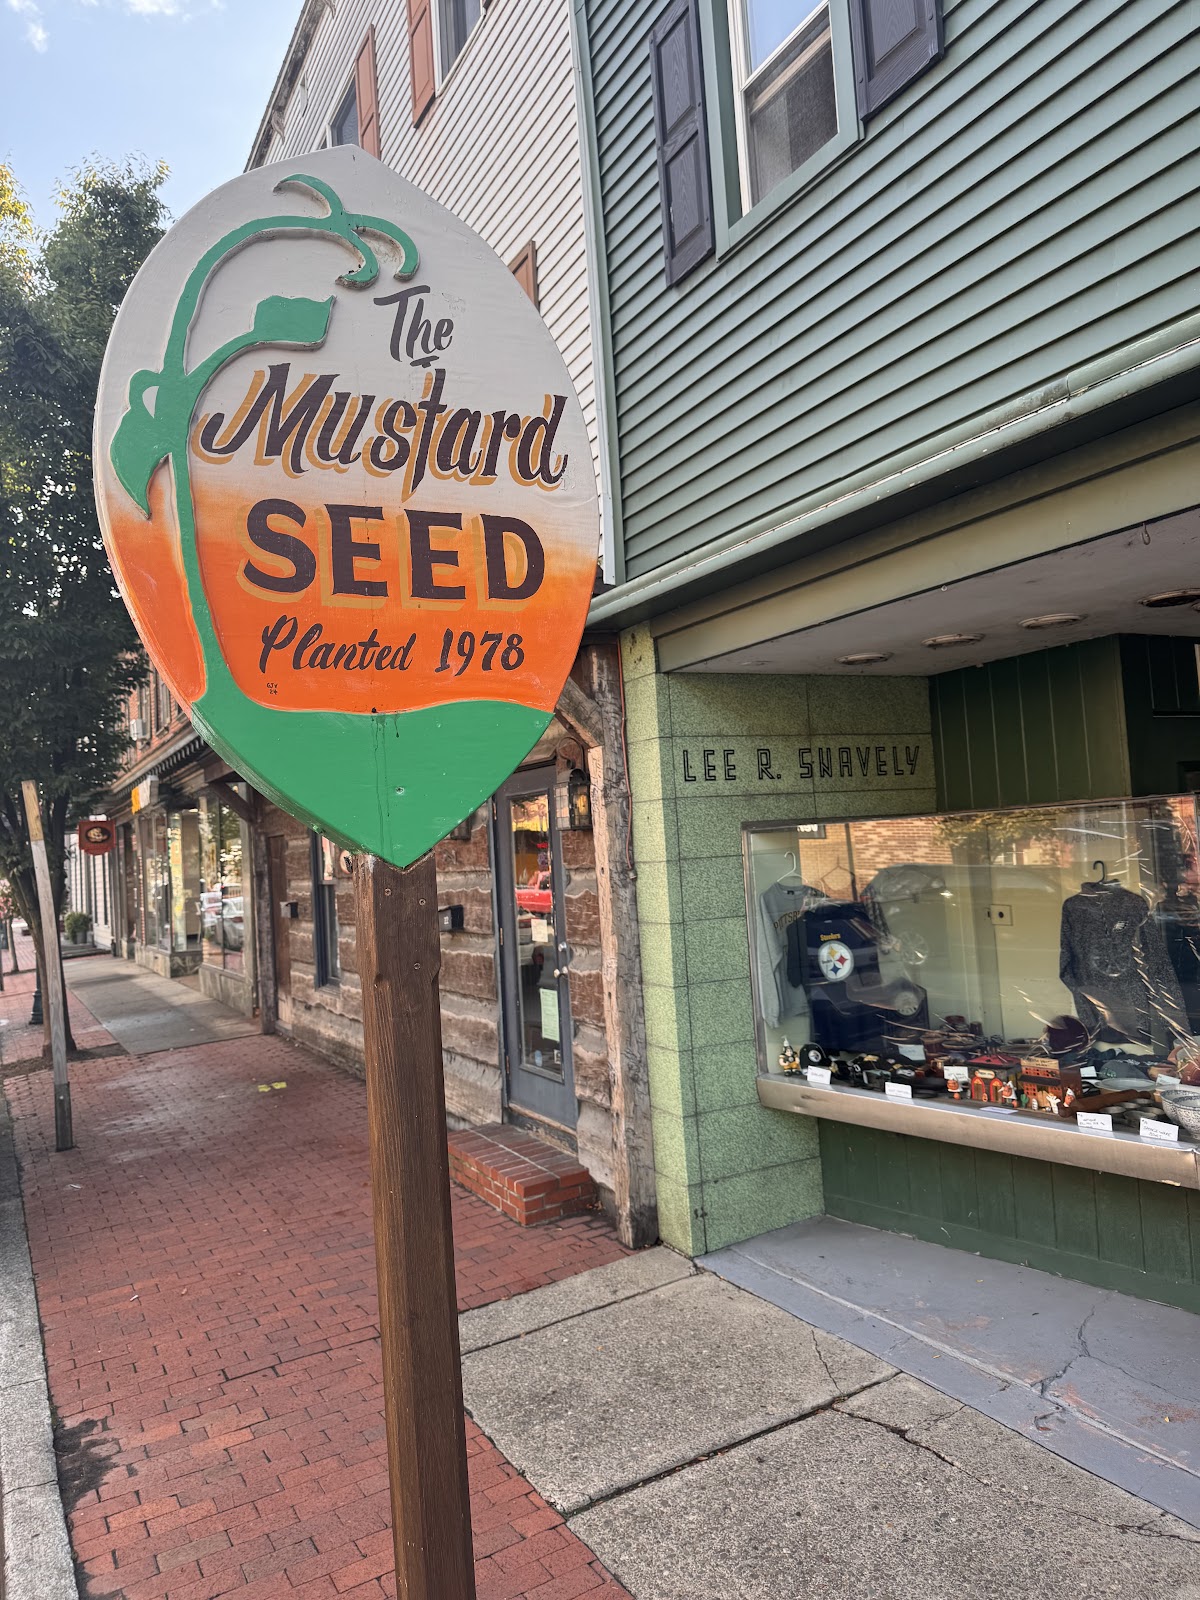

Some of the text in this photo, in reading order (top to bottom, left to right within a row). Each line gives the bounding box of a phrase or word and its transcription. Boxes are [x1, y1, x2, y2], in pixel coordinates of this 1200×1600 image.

[373, 285, 454, 362] The
[197, 363, 569, 494] Mustard
[242, 498, 546, 601] SEED
[258, 614, 525, 677] Planted 1978
[683, 745, 920, 781] LEE R. SNAVELY
